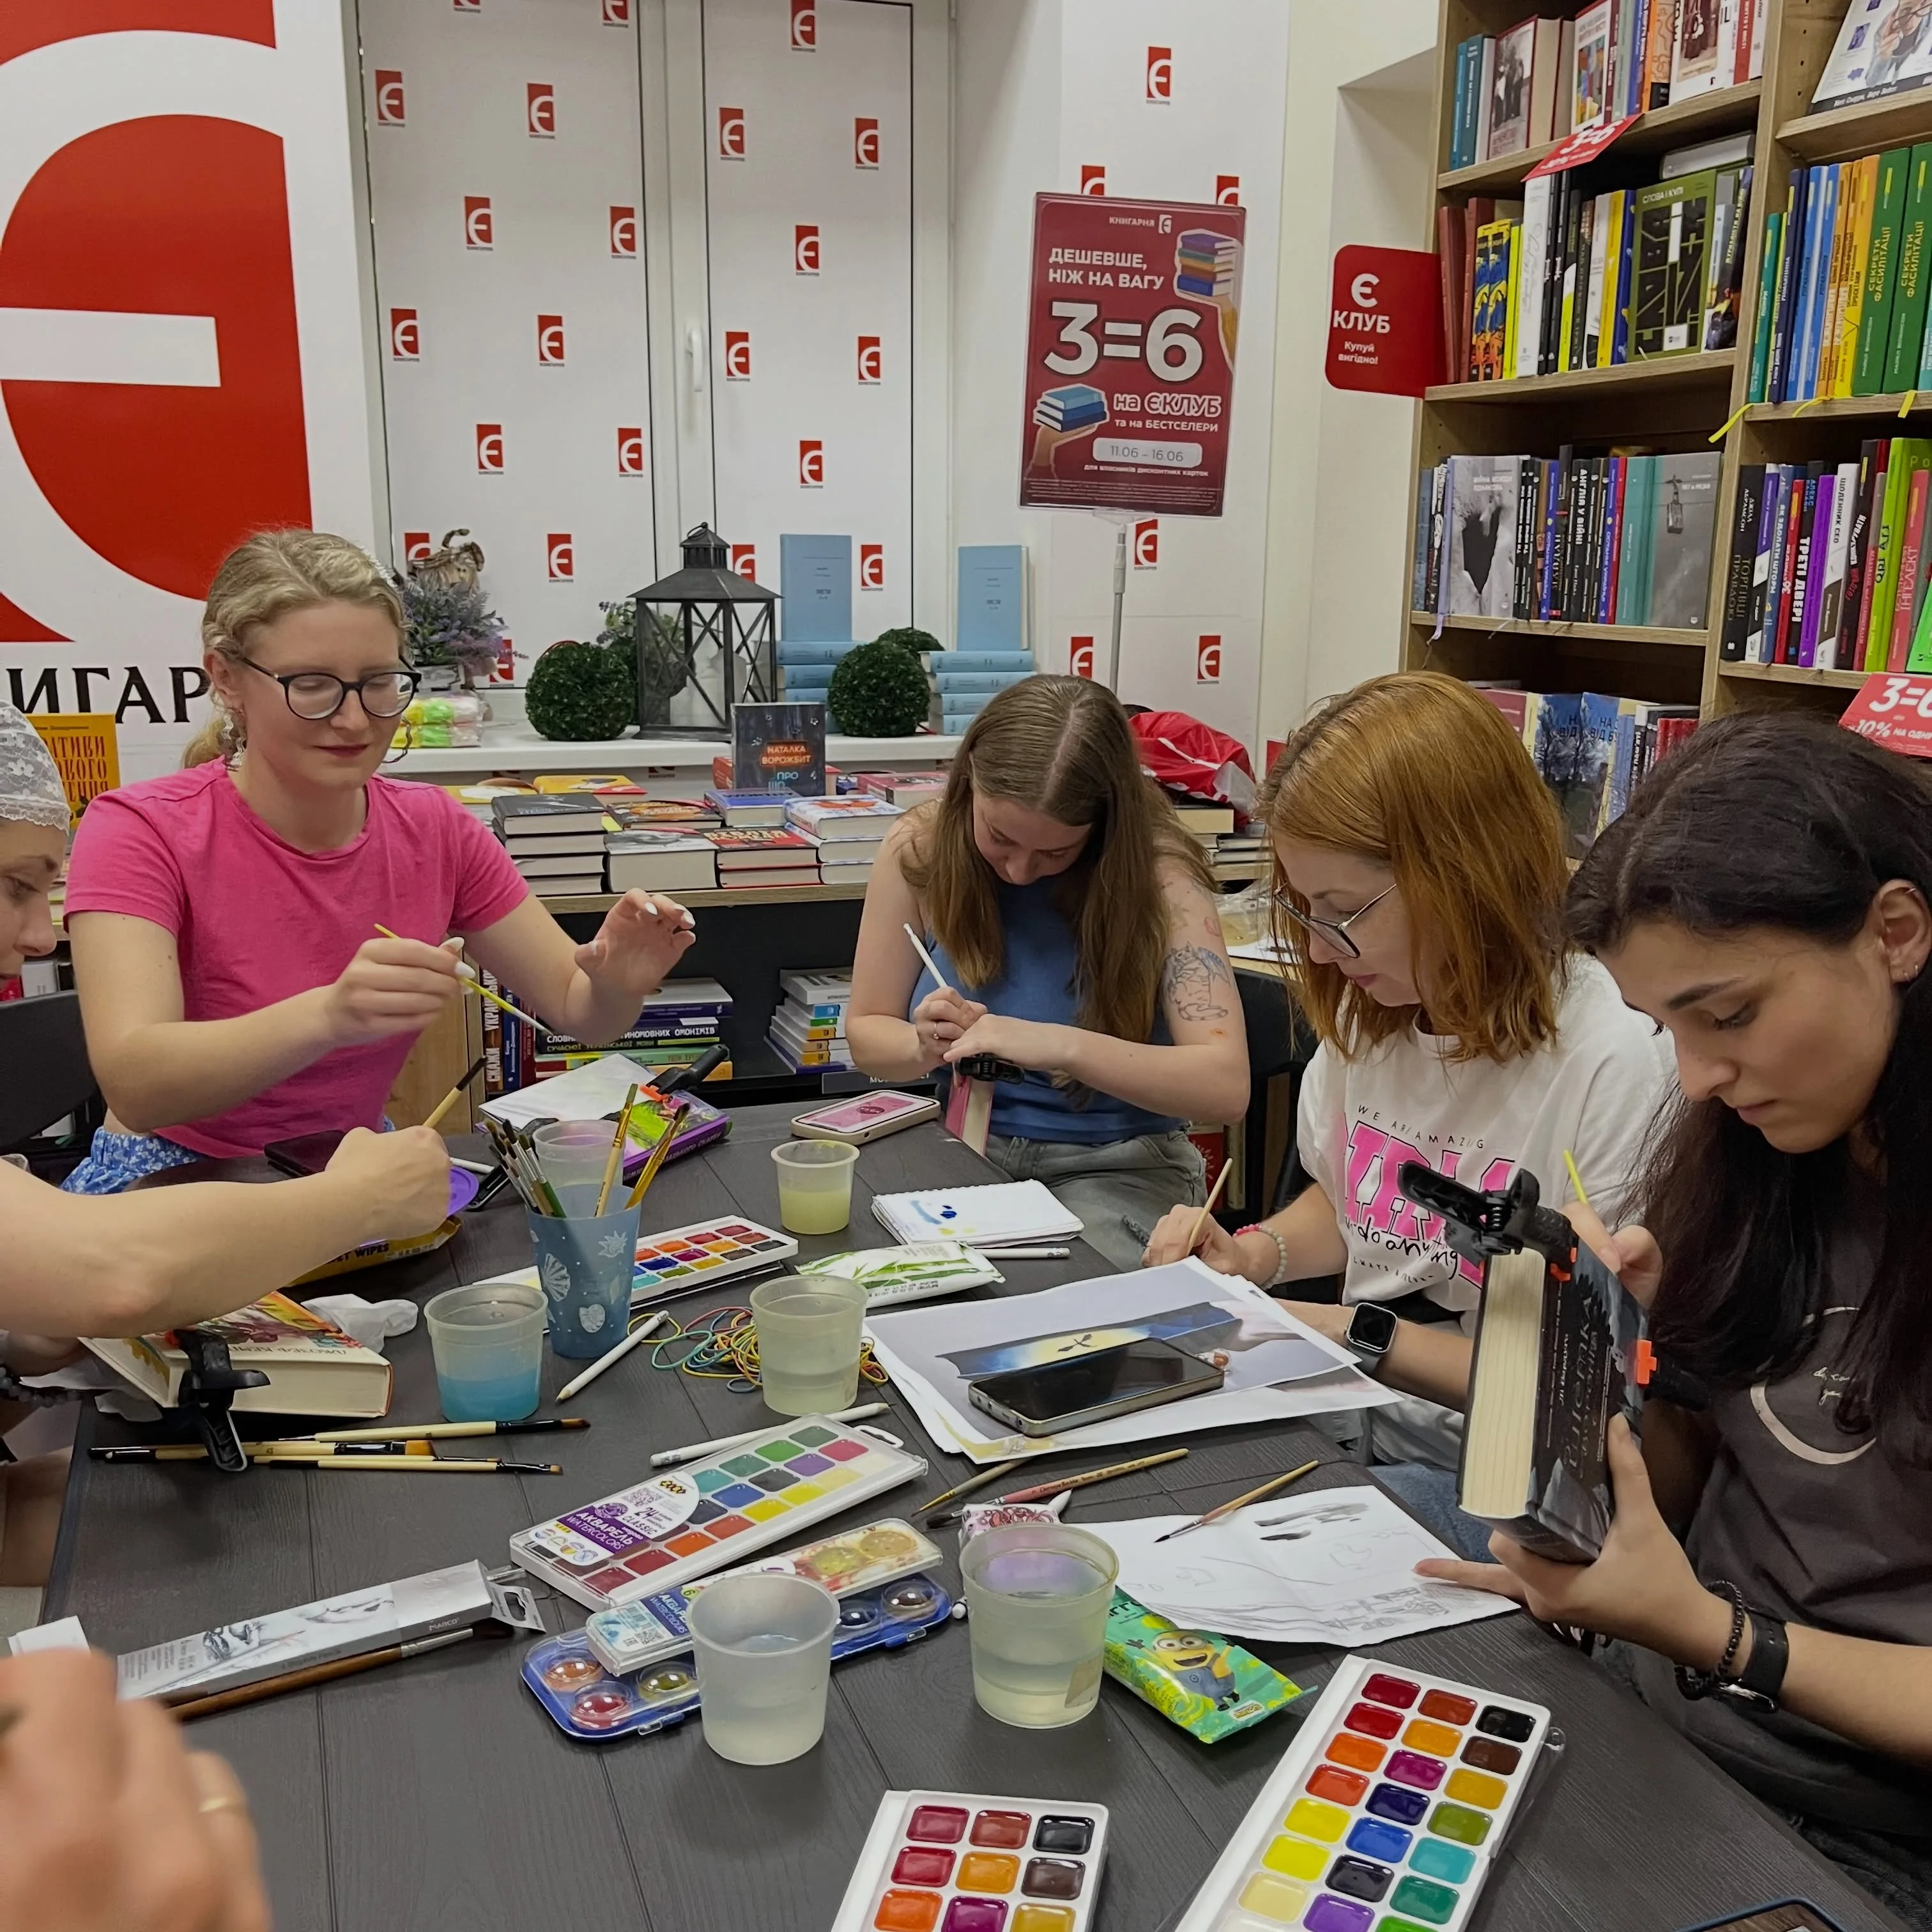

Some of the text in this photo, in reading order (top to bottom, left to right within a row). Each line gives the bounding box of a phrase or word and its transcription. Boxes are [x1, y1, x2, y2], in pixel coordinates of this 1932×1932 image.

[1109, 217, 1154, 227] КНИГАРНЯ
[1048, 248, 1147, 270] ДЕШЕВШЕ,
[1869, 239, 1882, 291] СЕКРЕТИ
[1874, 226, 1891, 302] ФАСИЛІТАЦІЇ
[1901, 234, 1913, 287] СЕКРЕТИ
[1906, 221, 1924, 297] ФАСИЛІТАЦІЇ
[1048, 269, 1165, 290] НІЖ НА ВАГУ
[1351, 273, 1380, 308] Є
[1333, 310, 1390, 334] КЛУБ
[1044, 302, 1203, 381] 3=6
[1344, 341, 1375, 352] Купуй
[1338, 353, 1378, 365] вигідно!
[1114, 392, 1222, 417] на ЄКЛУБ
[1114, 419, 1218, 432] та на БЕСТСЕЛЕРИ
[1110, 445, 1138, 458] 11.06
[1152, 449, 1184, 462] 16.06
[1575, 468, 1588, 545] АНГЛІЯ У ВІЙНІ
[1835, 477, 1846, 526] ЩОДЕННИК
[1774, 517, 1784, 560] ЗДОЛАТИ
[1736, 558, 1752, 618] ТОРГІВЦІ
[1770, 560, 1779, 594] ШТОРМ
[1791, 537, 1811, 622] ТРЕТІ ДВЕРІ
[1600, 717, 1612, 727] НА
[762, 755, 811, 765] ВОРОЖБИТ
[776, 771, 799, 780] ПРО
[675, 1027, 715, 1036] ОМОНІМІВ
[355, 1243, 390, 1258] WIPES
[566, 1515, 625, 1550] WATERCOLORS
[575, 1512, 633, 1545] АКВАРЕЛЬ
[622, 1515, 658, 1535] CLASSIC
[429, 1617, 460, 1632] MARCO
